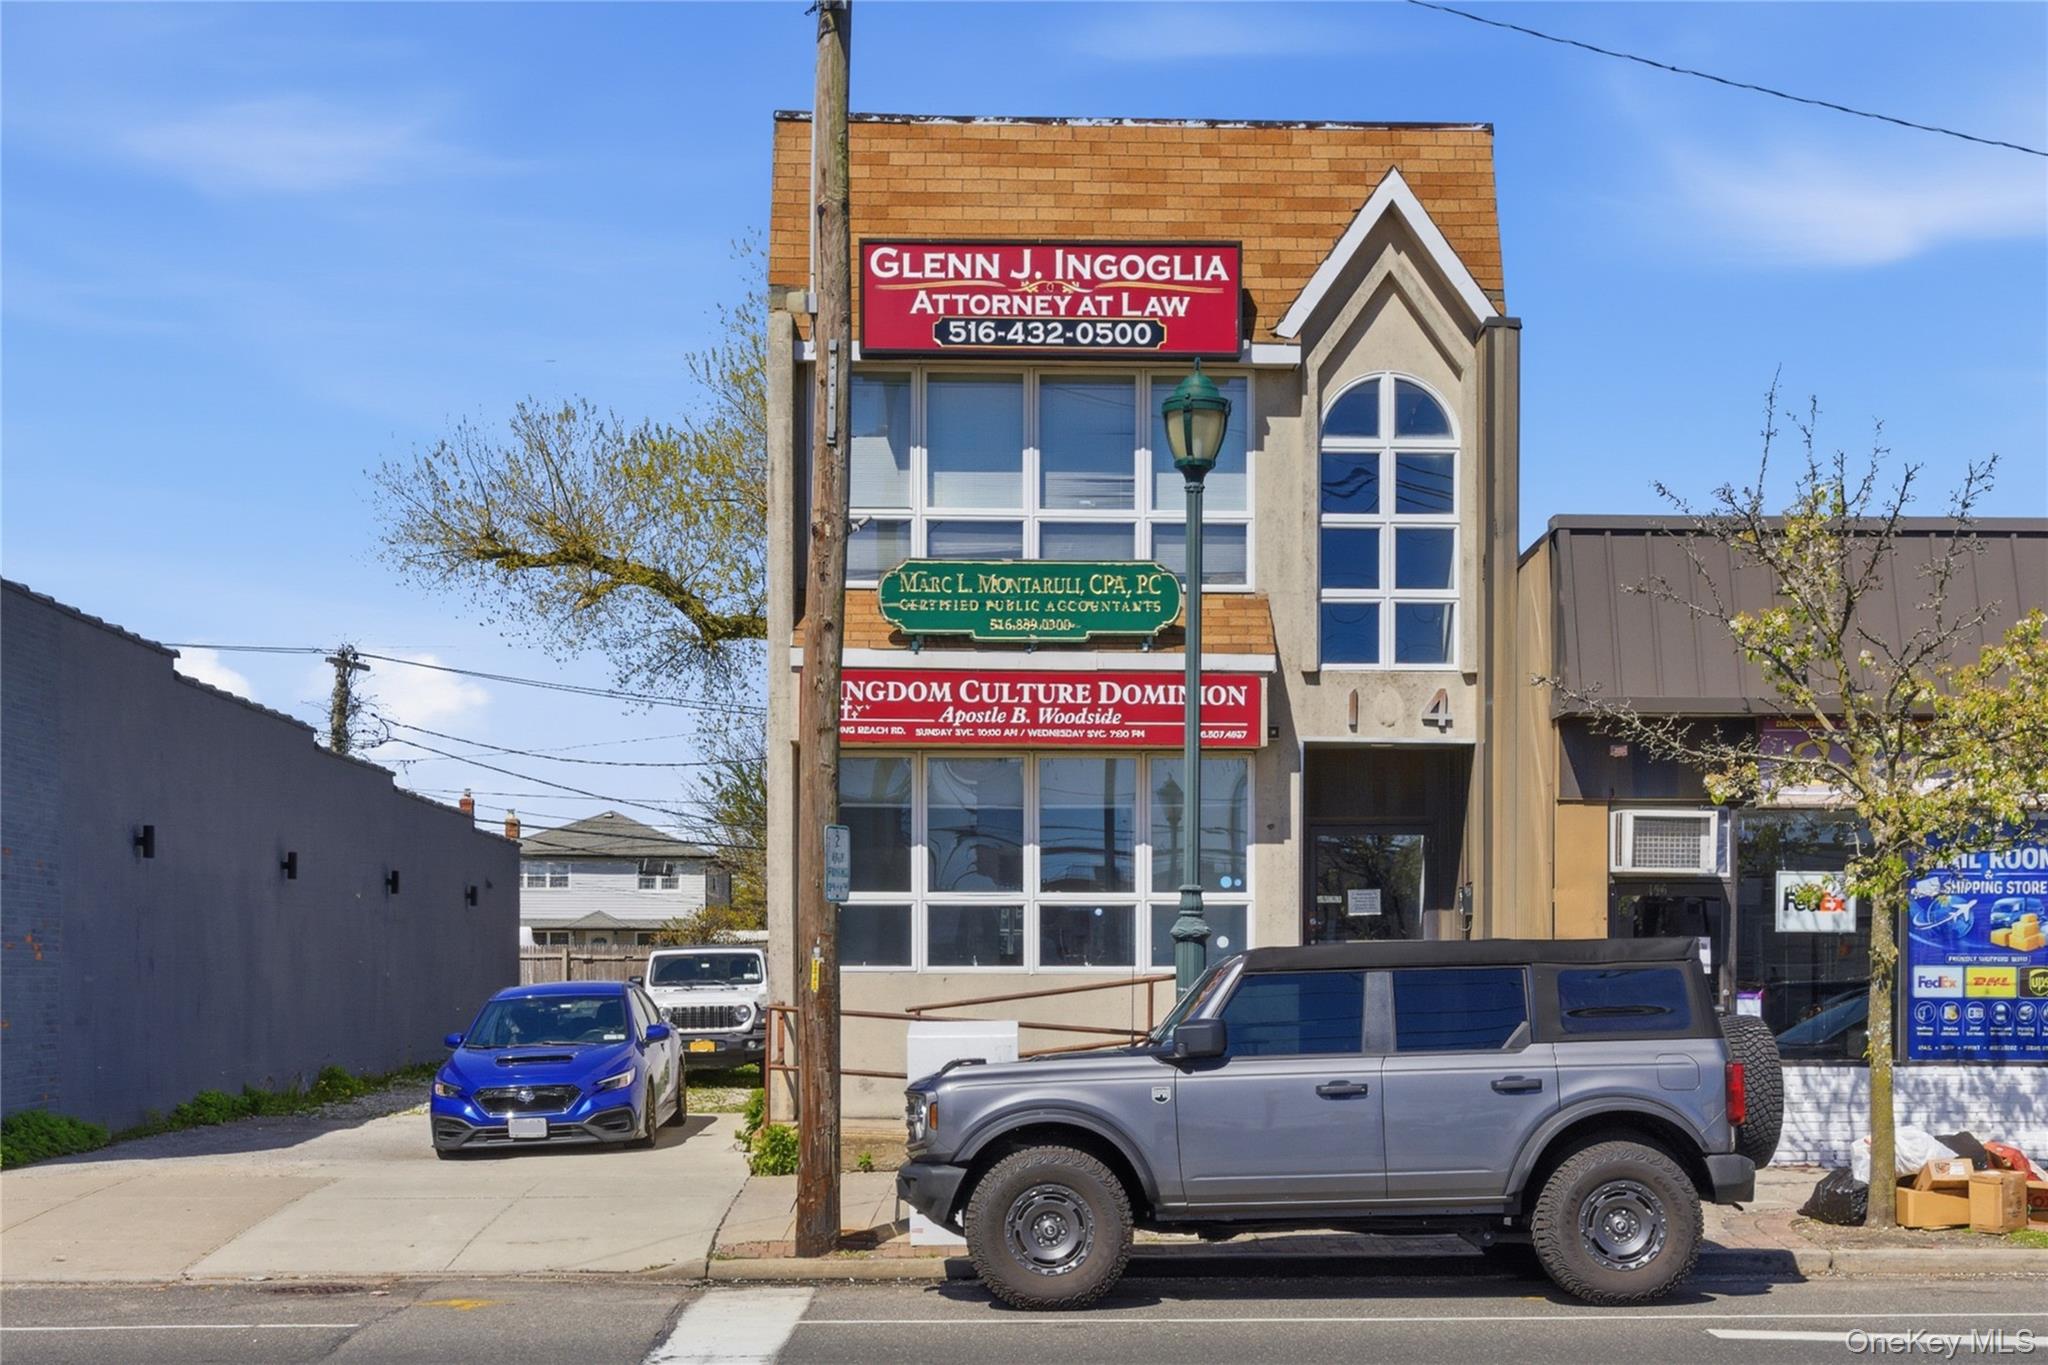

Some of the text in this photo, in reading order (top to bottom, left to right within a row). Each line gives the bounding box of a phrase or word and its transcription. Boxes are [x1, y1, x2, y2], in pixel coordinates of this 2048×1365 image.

[870, 247, 1229, 282] GLENN J. INGOGLIA
[910, 290, 1190, 317] ATTORNEY AT LAW
[947, 321, 1152, 345] 516-432-0500
[900, 571, 952, 593] MARC
[957, 573, 973, 593] L.
[1089, 574, 1132, 598] CPA,
[1137, 574, 1162, 595] PC
[900, 600, 1162, 613] CERTIFIED PUBLIC ACCOUNTANTS
[840, 680, 953, 703] NGDOM
[959, 679, 1092, 705] CULTURE
[938, 706, 1122, 726] Apostle B. Woodside
[857, 726, 889, 735] BEACH
[915, 728, 953, 736] SUNDAY
[1003, 729, 1018, 737] AM
[1027, 729, 1085, 738] WEDNESDAY
[1943, 880, 2048, 895] SHIPPING STORE
[1918, 975, 1957, 989] FedEx
[1973, 976, 2011, 987] DHL
